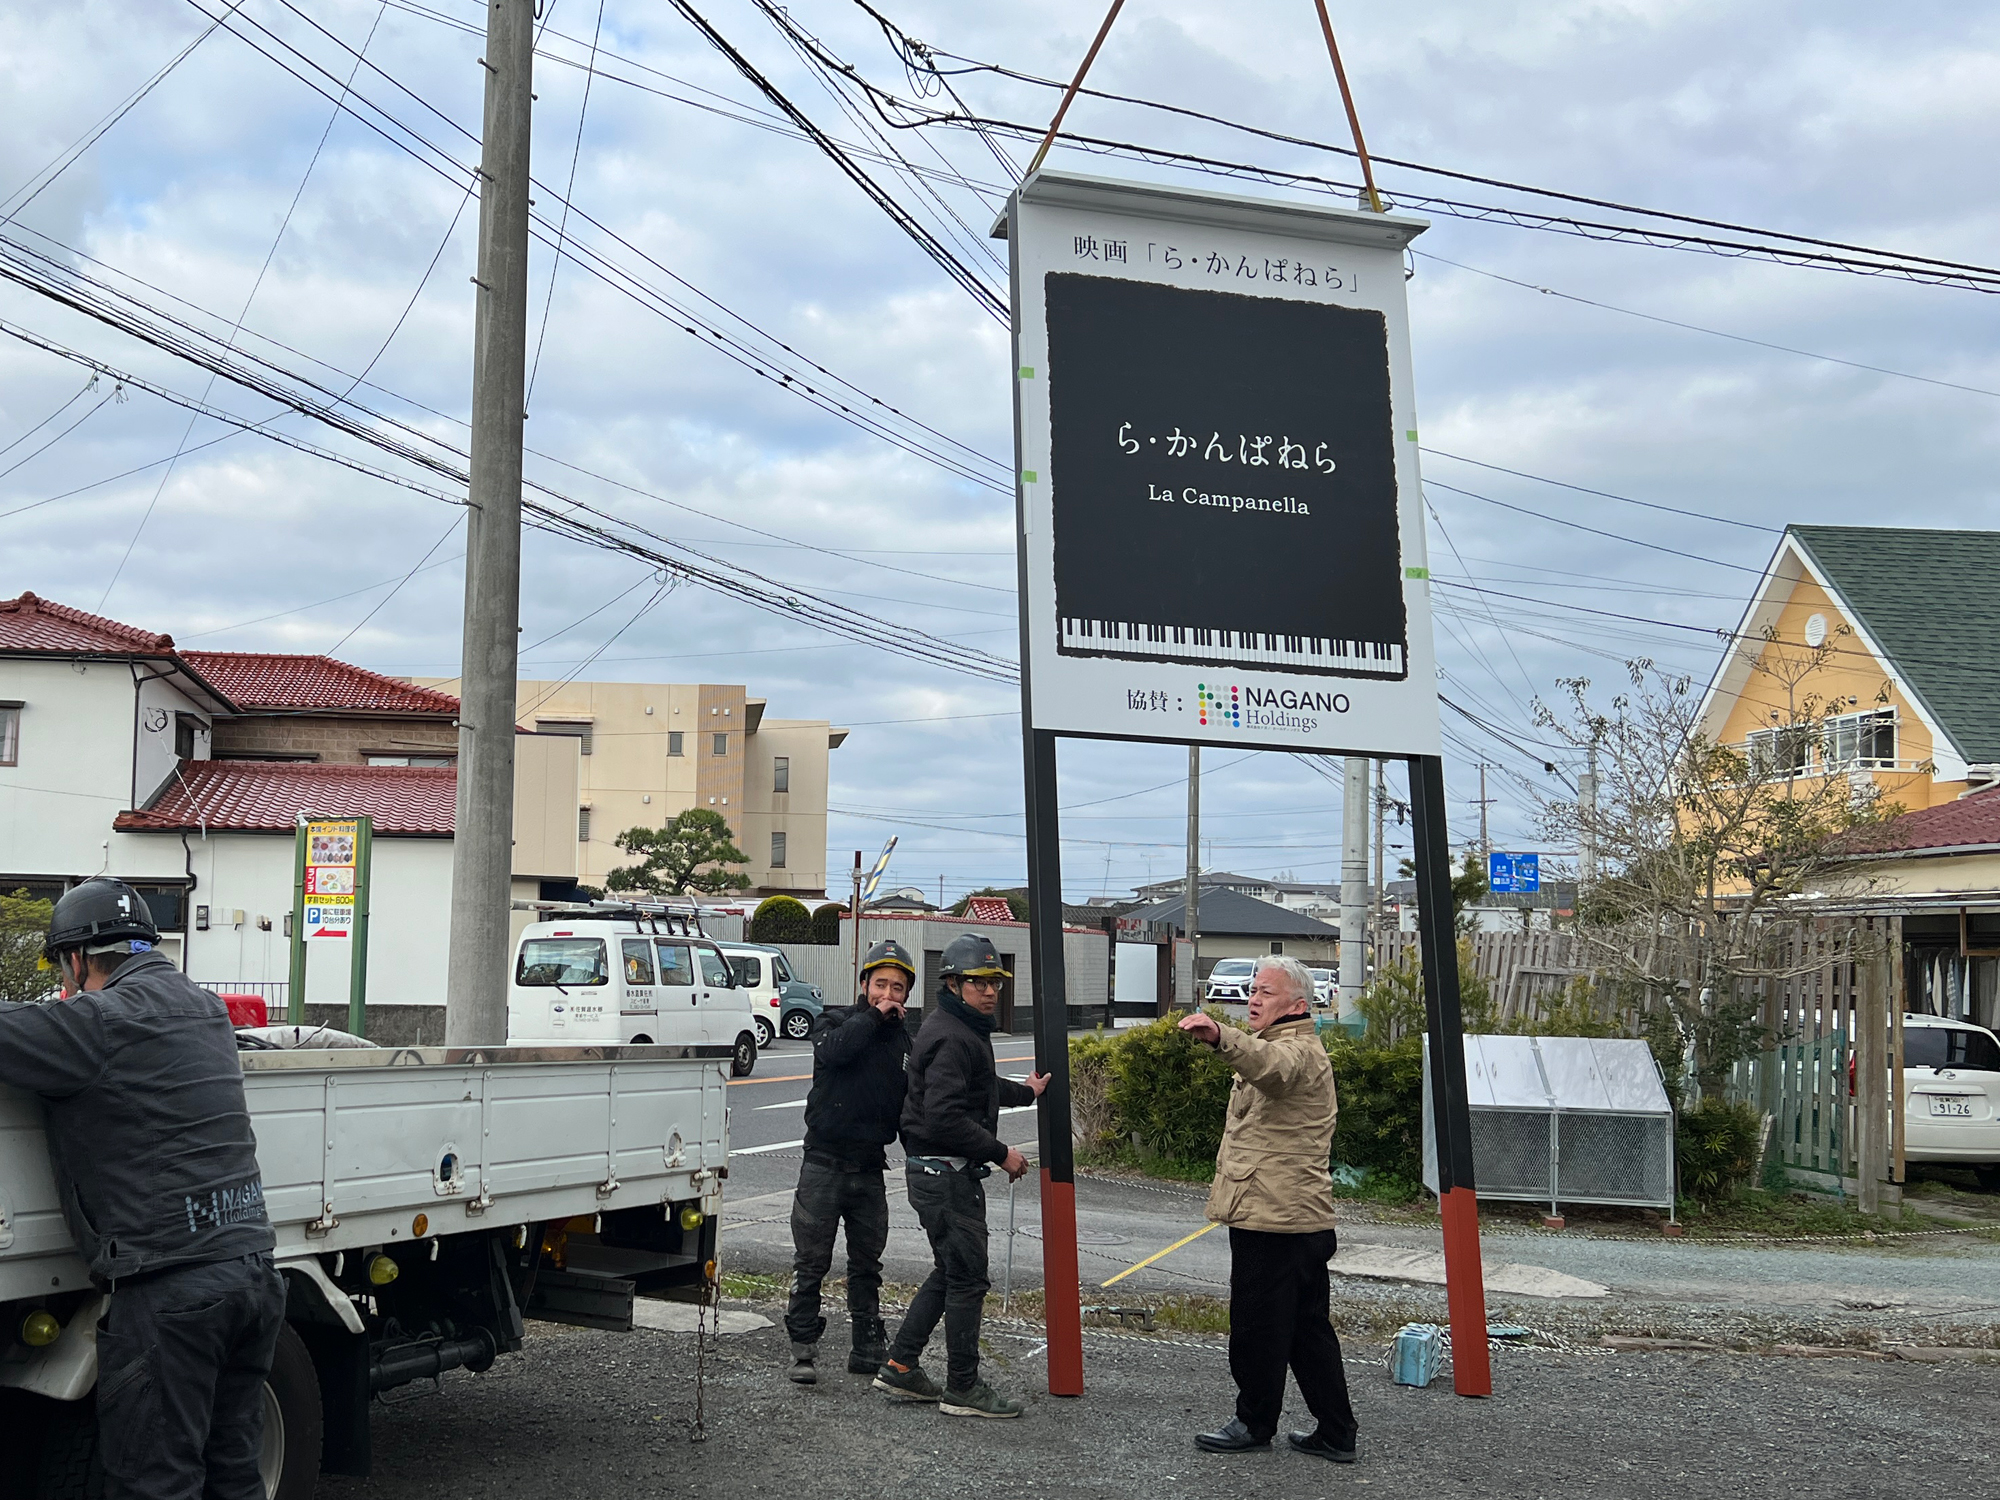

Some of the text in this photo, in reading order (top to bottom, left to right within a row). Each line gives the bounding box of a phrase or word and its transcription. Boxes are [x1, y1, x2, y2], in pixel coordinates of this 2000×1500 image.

[1073, 235, 1358, 293] 映画「ら・かんぱねら」
[1117, 421, 1337, 475] ら・かんぱねら
[1148, 484, 1310, 515] La Campanella
[1245, 686, 1351, 714] NAGANO
[1245, 709, 1318, 733] Holdings
[307, 868, 315, 892] ランチ
[309, 909, 319, 923] P
[322, 916, 351, 924] 10台分あり
[1939, 1103, 1970, 1114] 91-26
